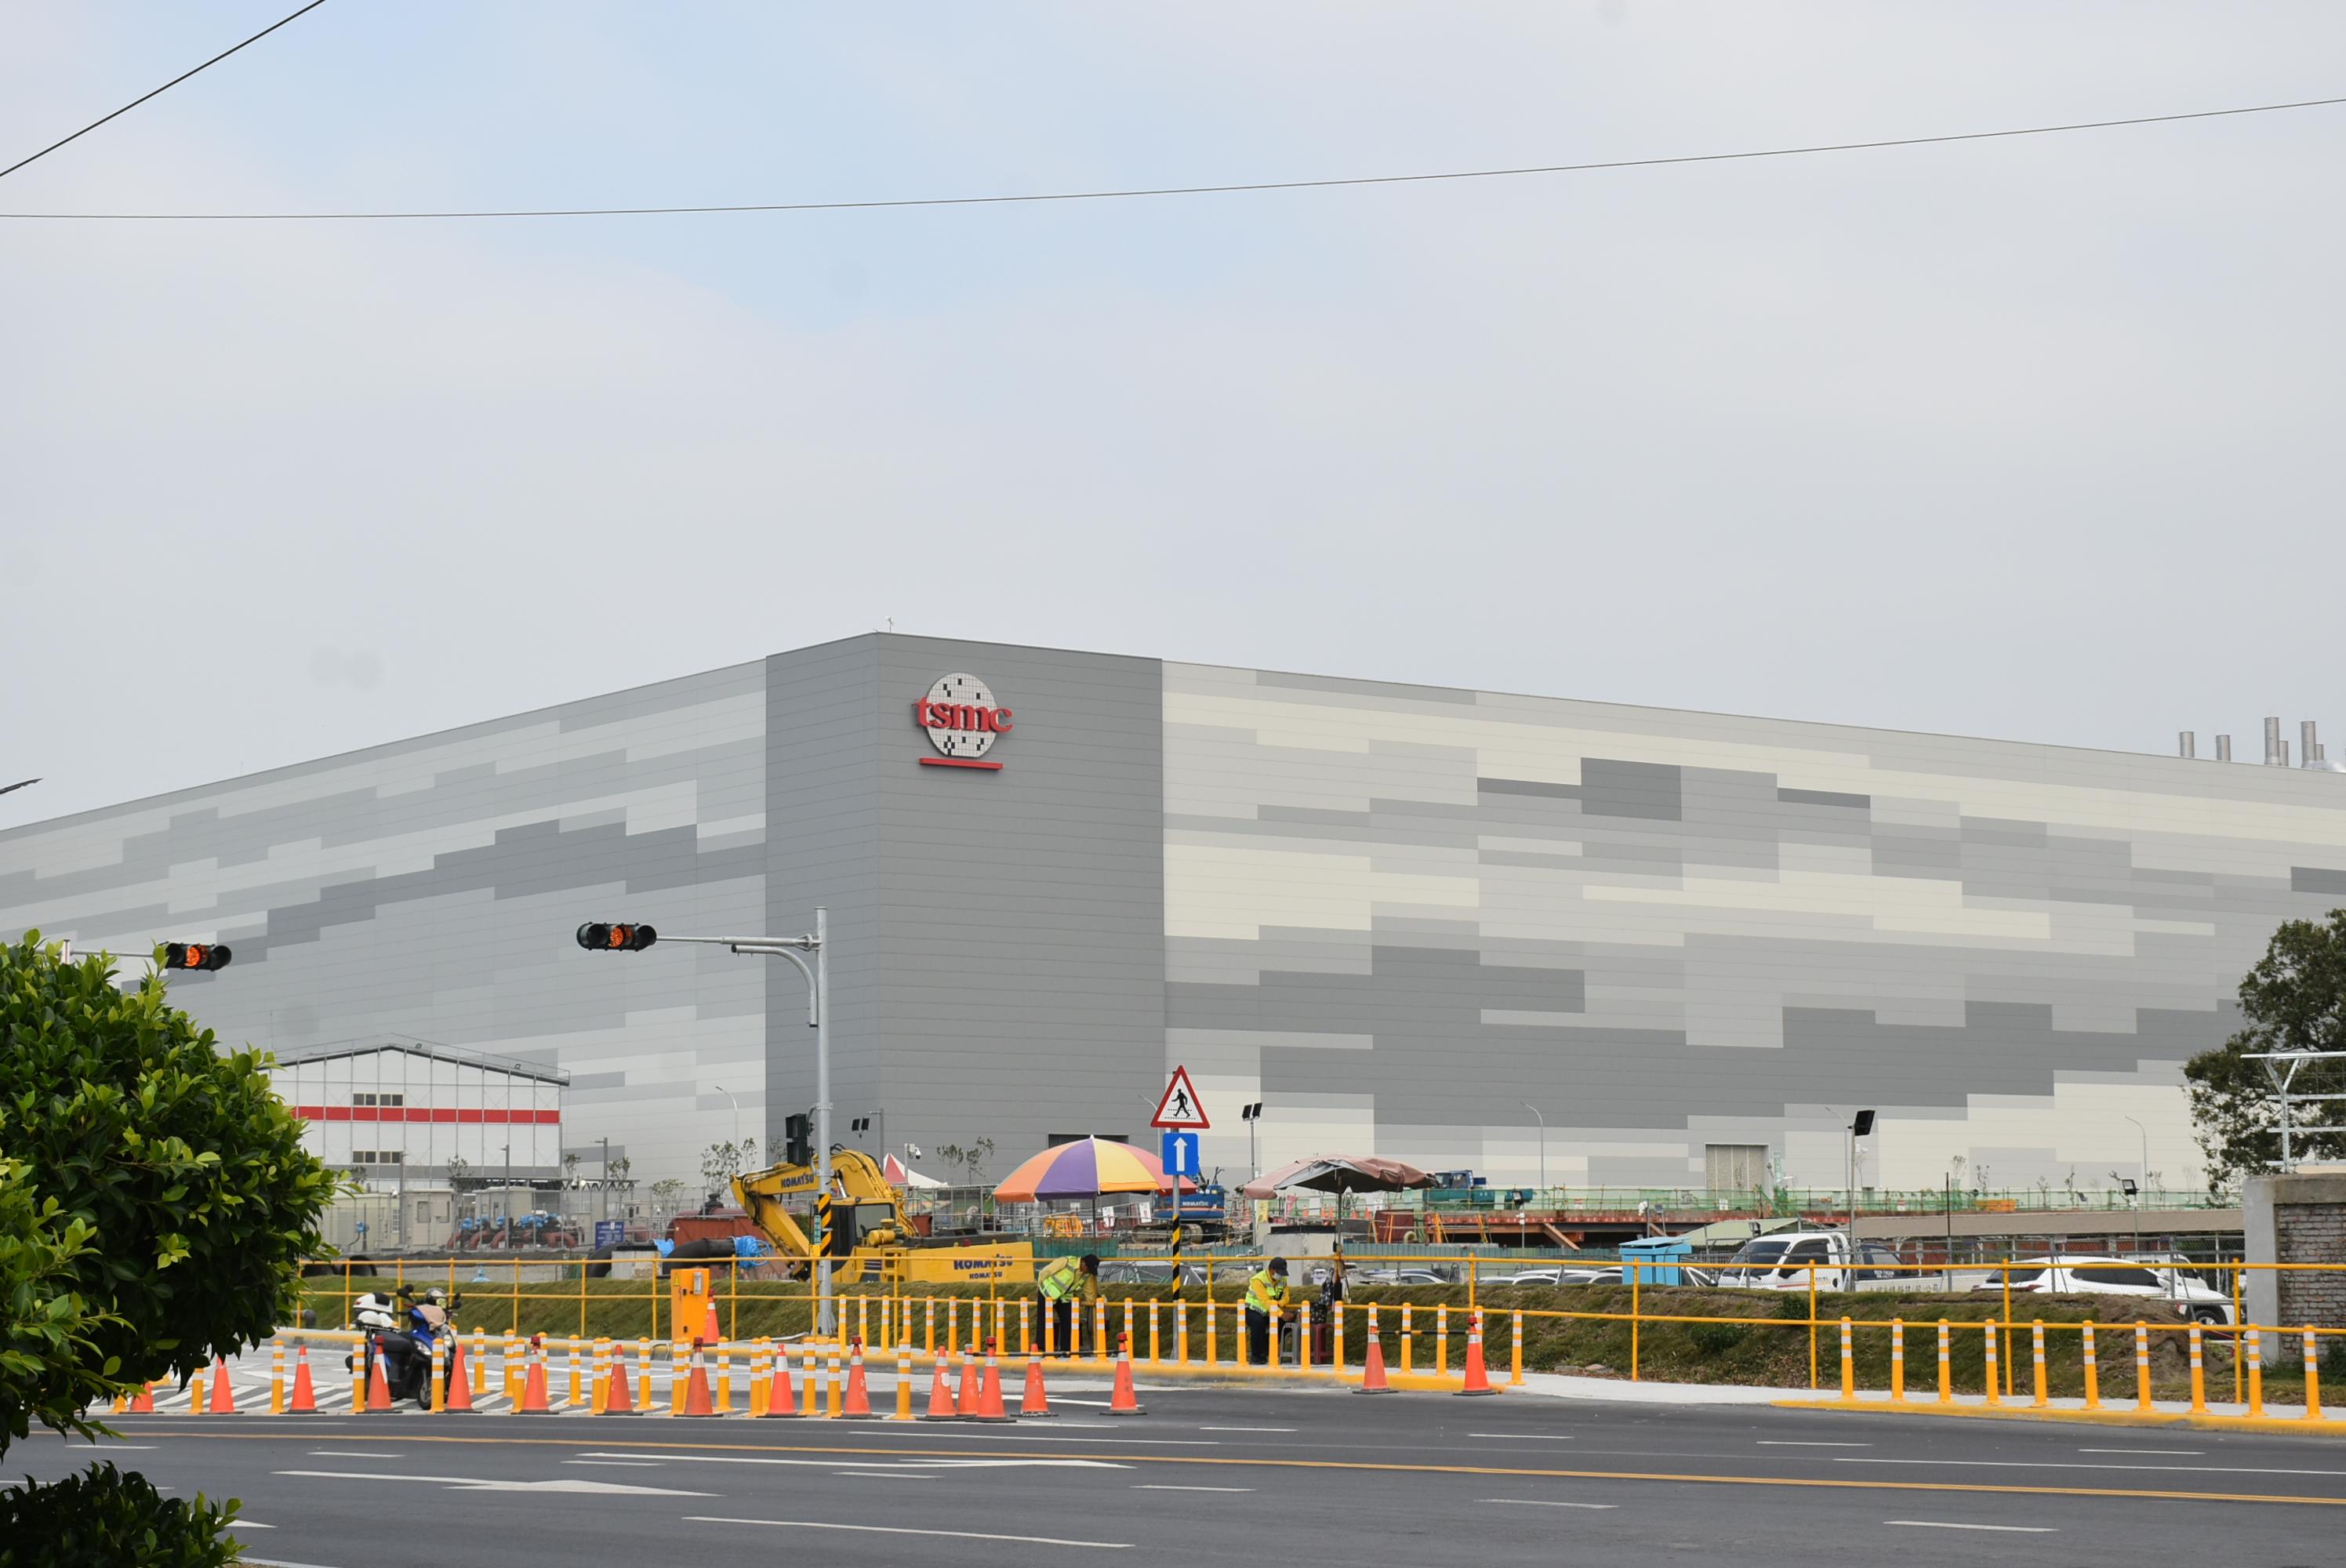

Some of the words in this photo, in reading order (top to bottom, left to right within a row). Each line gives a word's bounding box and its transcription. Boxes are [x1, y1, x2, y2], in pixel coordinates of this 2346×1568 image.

[914, 696, 1014, 732] tsmc
[780, 1172, 815, 1189] KOMATSU
[969, 1271, 1003, 1279] KOMASU
